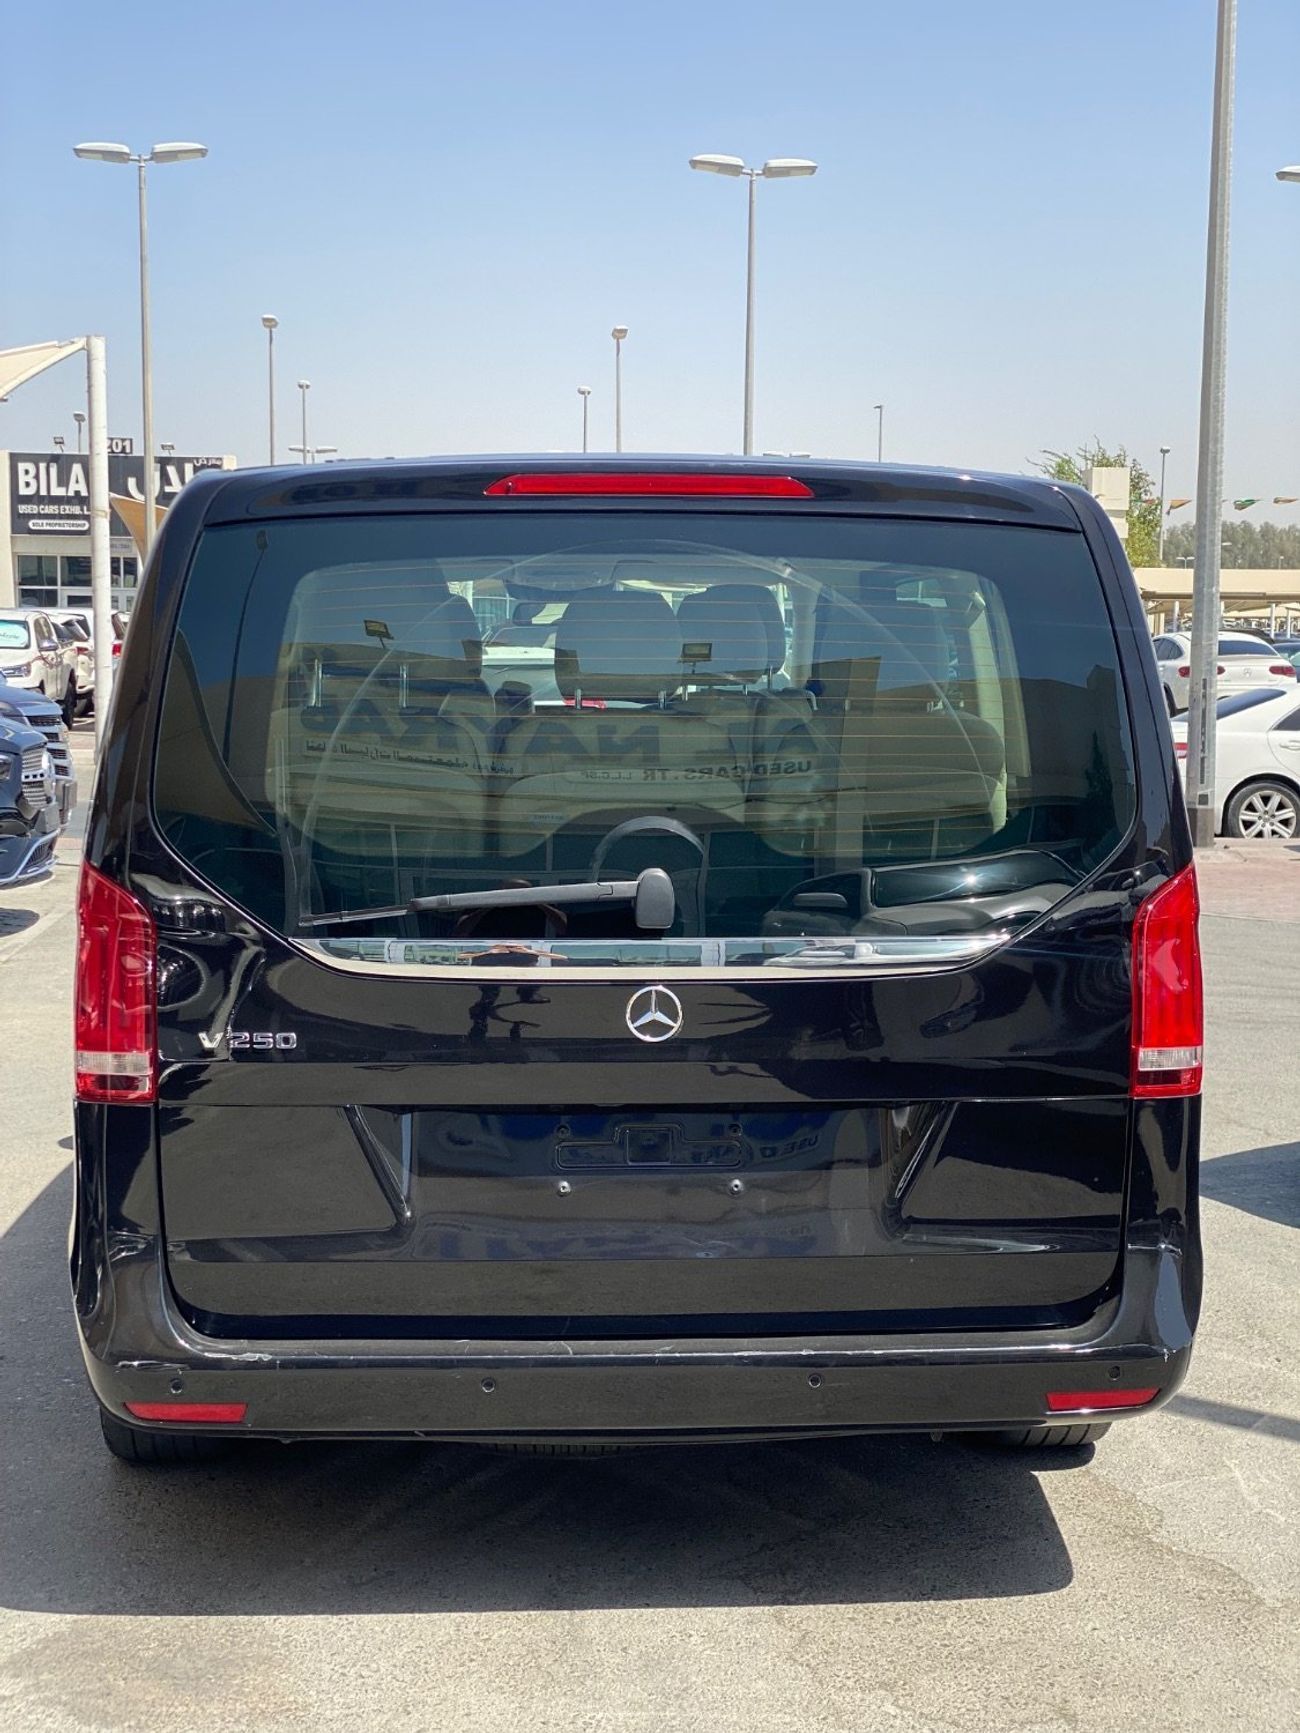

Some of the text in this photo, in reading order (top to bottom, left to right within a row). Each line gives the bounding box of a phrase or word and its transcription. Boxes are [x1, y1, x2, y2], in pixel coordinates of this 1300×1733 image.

[17, 462, 89, 496] BILA
[127, 463, 194, 502] لال
[18, 504, 38, 514] USED
[39, 504, 59, 515] CARS
[31, 521, 86, 530] SOLE PROPRIETORSHIP
